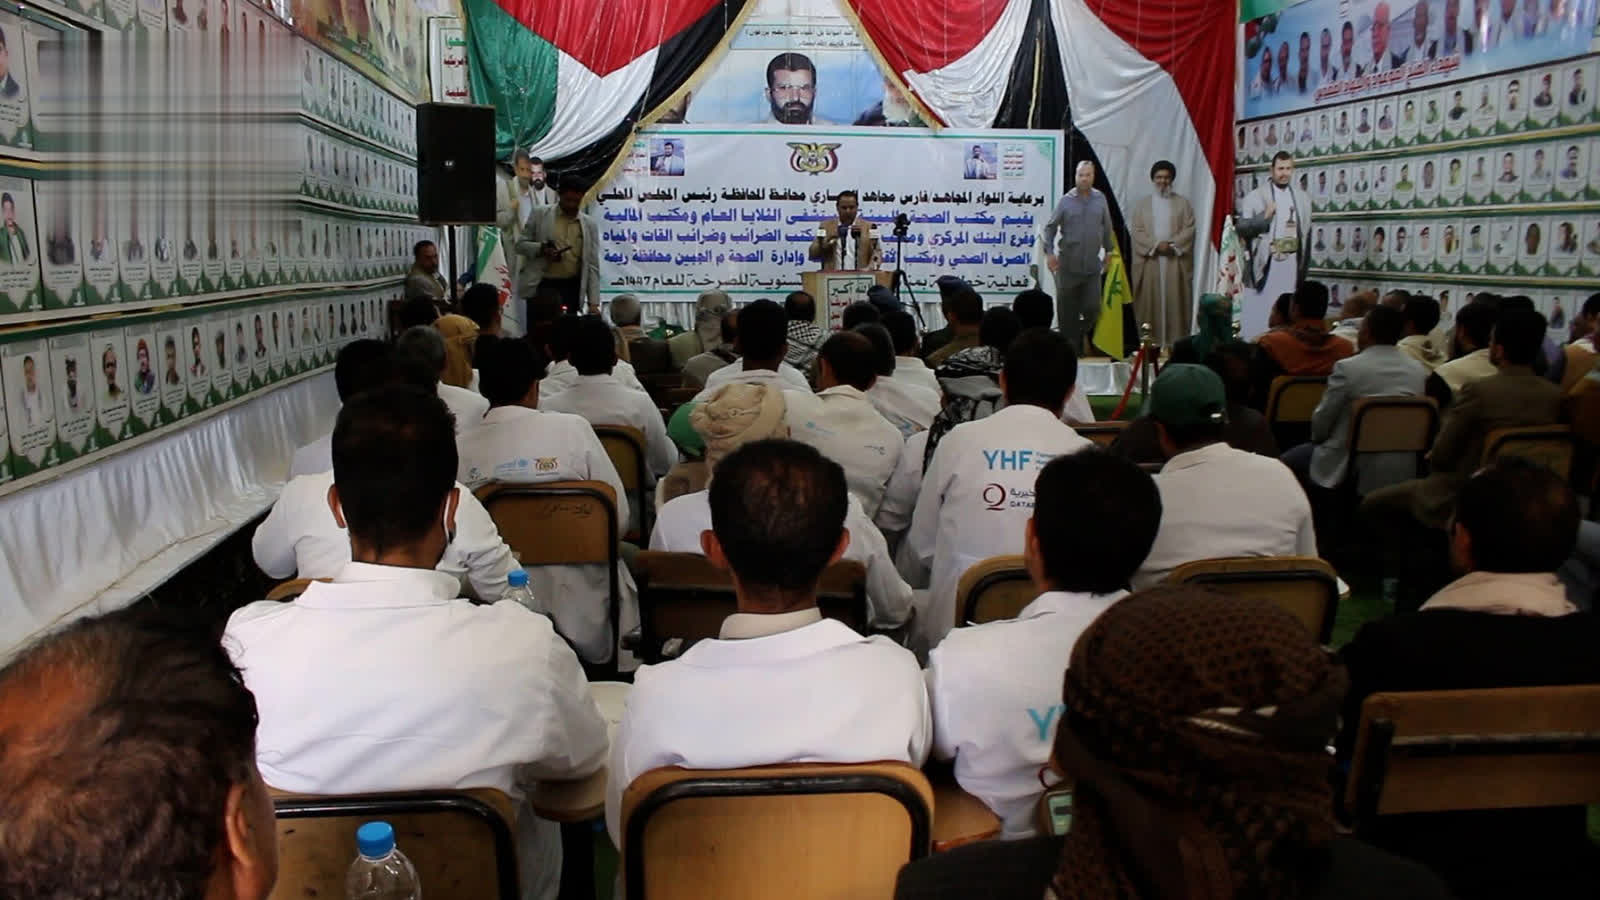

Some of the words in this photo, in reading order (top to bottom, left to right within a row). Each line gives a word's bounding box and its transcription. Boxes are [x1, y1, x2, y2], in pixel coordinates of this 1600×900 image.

[638, 187, 677, 202] المجلس
[682, 187, 717, 203] رئيس
[768, 187, 806, 201] محافظ
[862, 190, 896, 204] مجاهد
[976, 191, 1005, 206] اللواء
[1008, 191, 1045, 207] برعاية
[603, 207, 642, 225] المالية
[647, 207, 698, 225] ومكتب
[701, 207, 737, 226] العام
[910, 209, 950, 224] الصحة
[954, 210, 996, 227] مكتب
[1002, 210, 1034, 228] يقيم
[602, 228, 638, 245] والمياه
[641, 228, 673, 242] القات
[676, 228, 727, 245] وضرائب
[730, 228, 781, 245] الضرائب
[928, 229, 968, 249] المركزي
[973, 231, 1006, 248] البنك
[1010, 231, 1035, 248] وفرع
[603, 248, 629, 265] ريمة
[632, 248, 672, 262] محافظة
[674, 249, 712, 266] الجبين
[715, 253, 726, 267] م
[728, 248, 764, 263] الصحة
[770, 249, 805, 265] وإدارة
[903, 250, 945, 266] ومكتب
[948, 251, 988, 270] الصحي
[991, 251, 1031, 267] الصرف
[987, 275, 1030, 291] فعالية
[982, 449, 1033, 471] YHF
